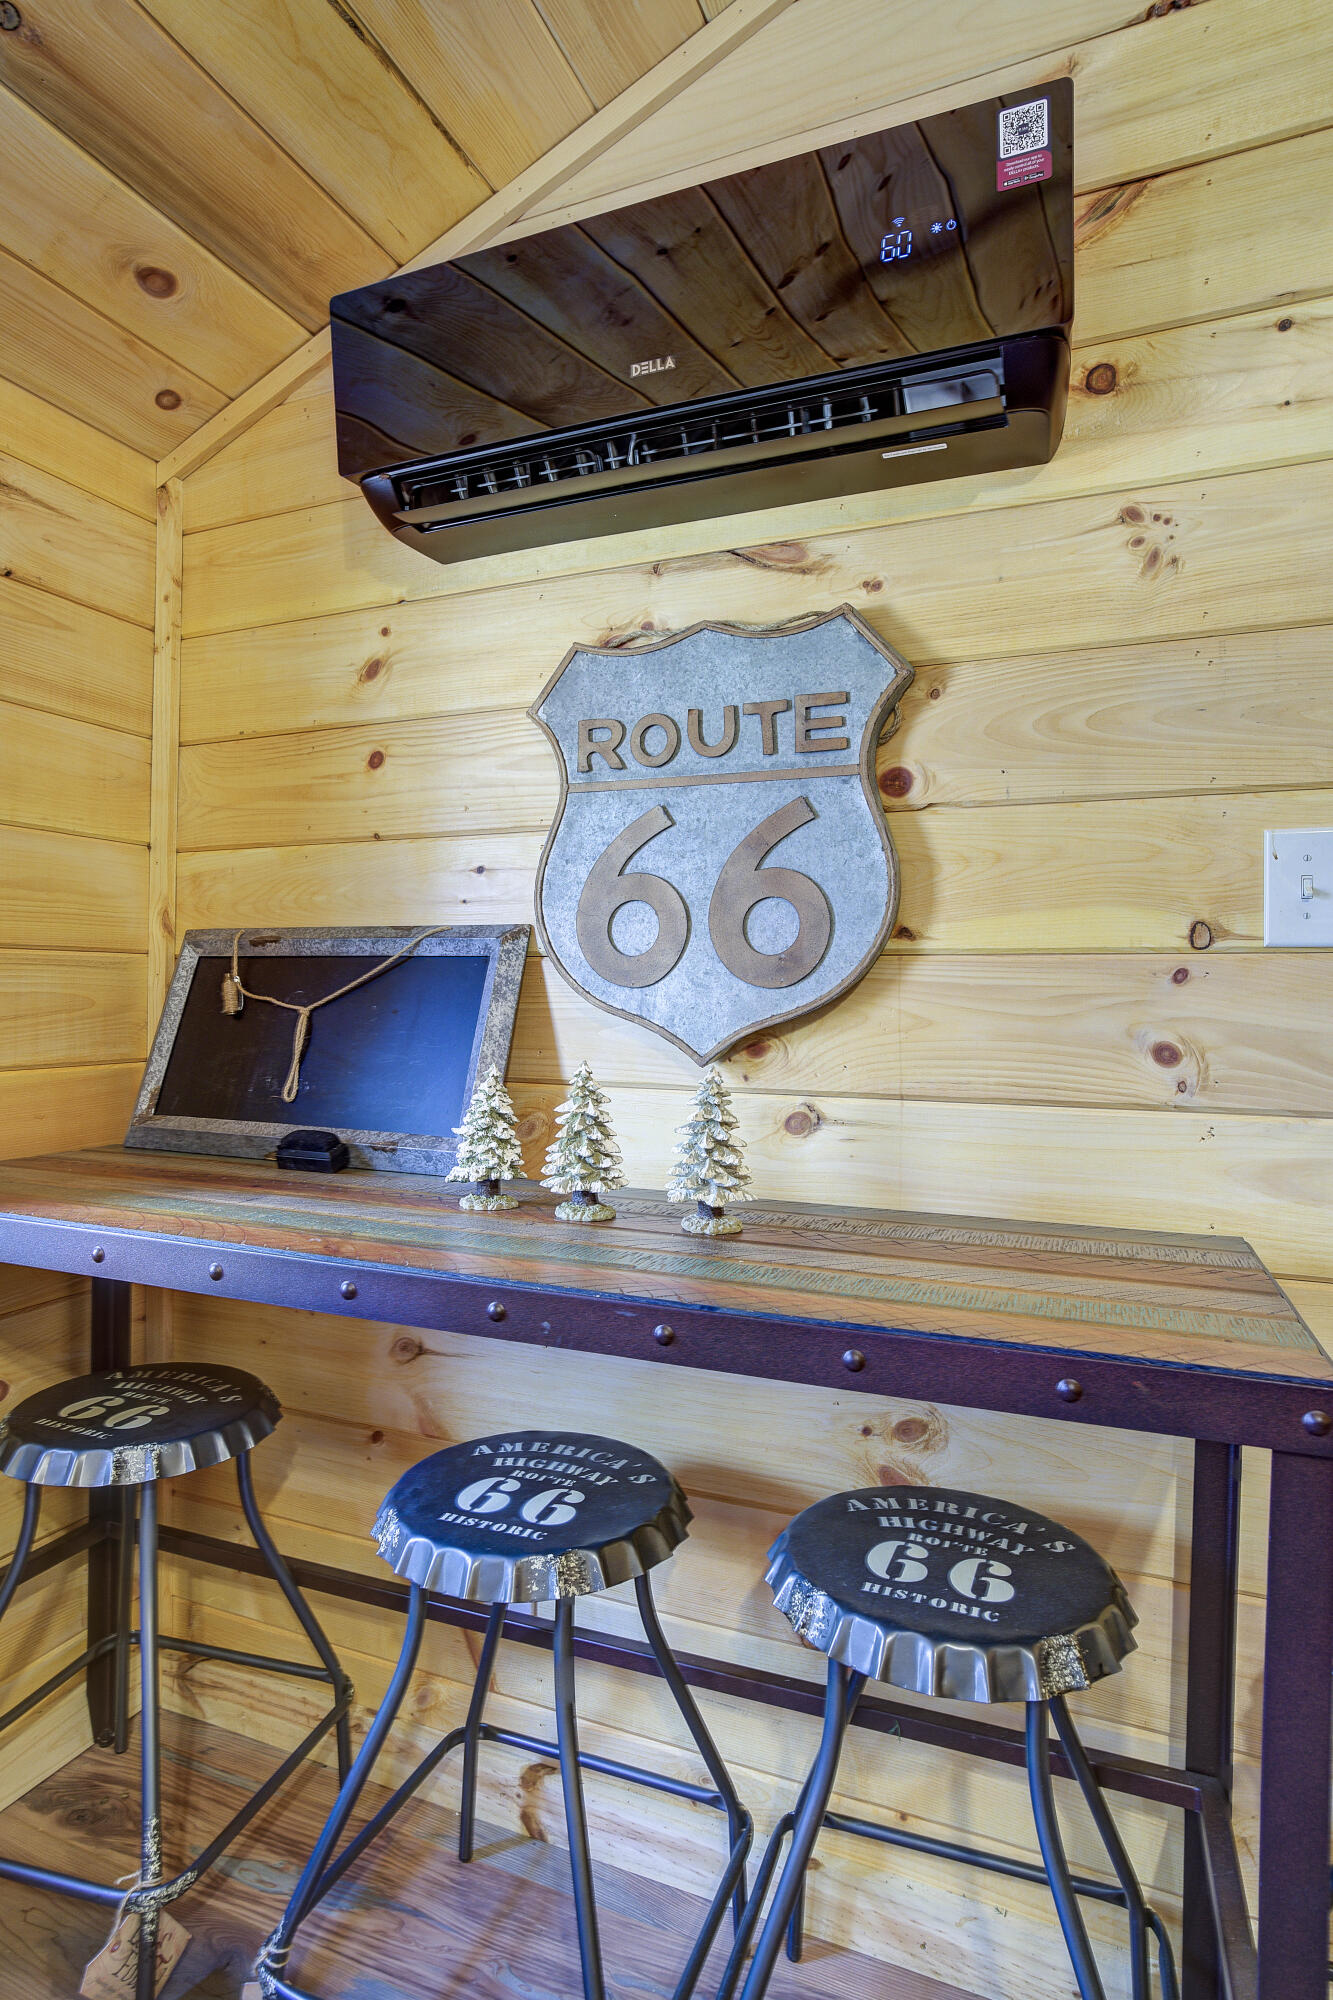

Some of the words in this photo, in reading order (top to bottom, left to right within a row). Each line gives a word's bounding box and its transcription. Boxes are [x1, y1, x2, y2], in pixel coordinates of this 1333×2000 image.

[880, 230, 912, 262] 60
[631, 356, 676, 377] DELLA
[577, 691, 849, 772] ROUTE
[576, 796, 835, 988] 66
[104, 1371, 243, 1403] AMERICA'S
[112, 1382, 208, 1404] HIGHWAY
[34, 1418, 114, 1440] HISTORIC
[57, 1395, 170, 1430] 66
[472, 1441, 657, 1484] AMERICA'S
[492, 1457, 619, 1487] HIGHWAY
[510, 1468, 577, 1487] ROUTE
[455, 1476, 586, 1526] 66
[437, 1512, 548, 1541] HISTORIC
[847, 1498, 1077, 1554] AMERICA'S
[877, 1516, 1036, 1556] HIGHWAY
[907, 1532, 989, 1556] ROUTE
[866, 1540, 1015, 1603] 66
[860, 1581, 1001, 1623] HISTORIC
